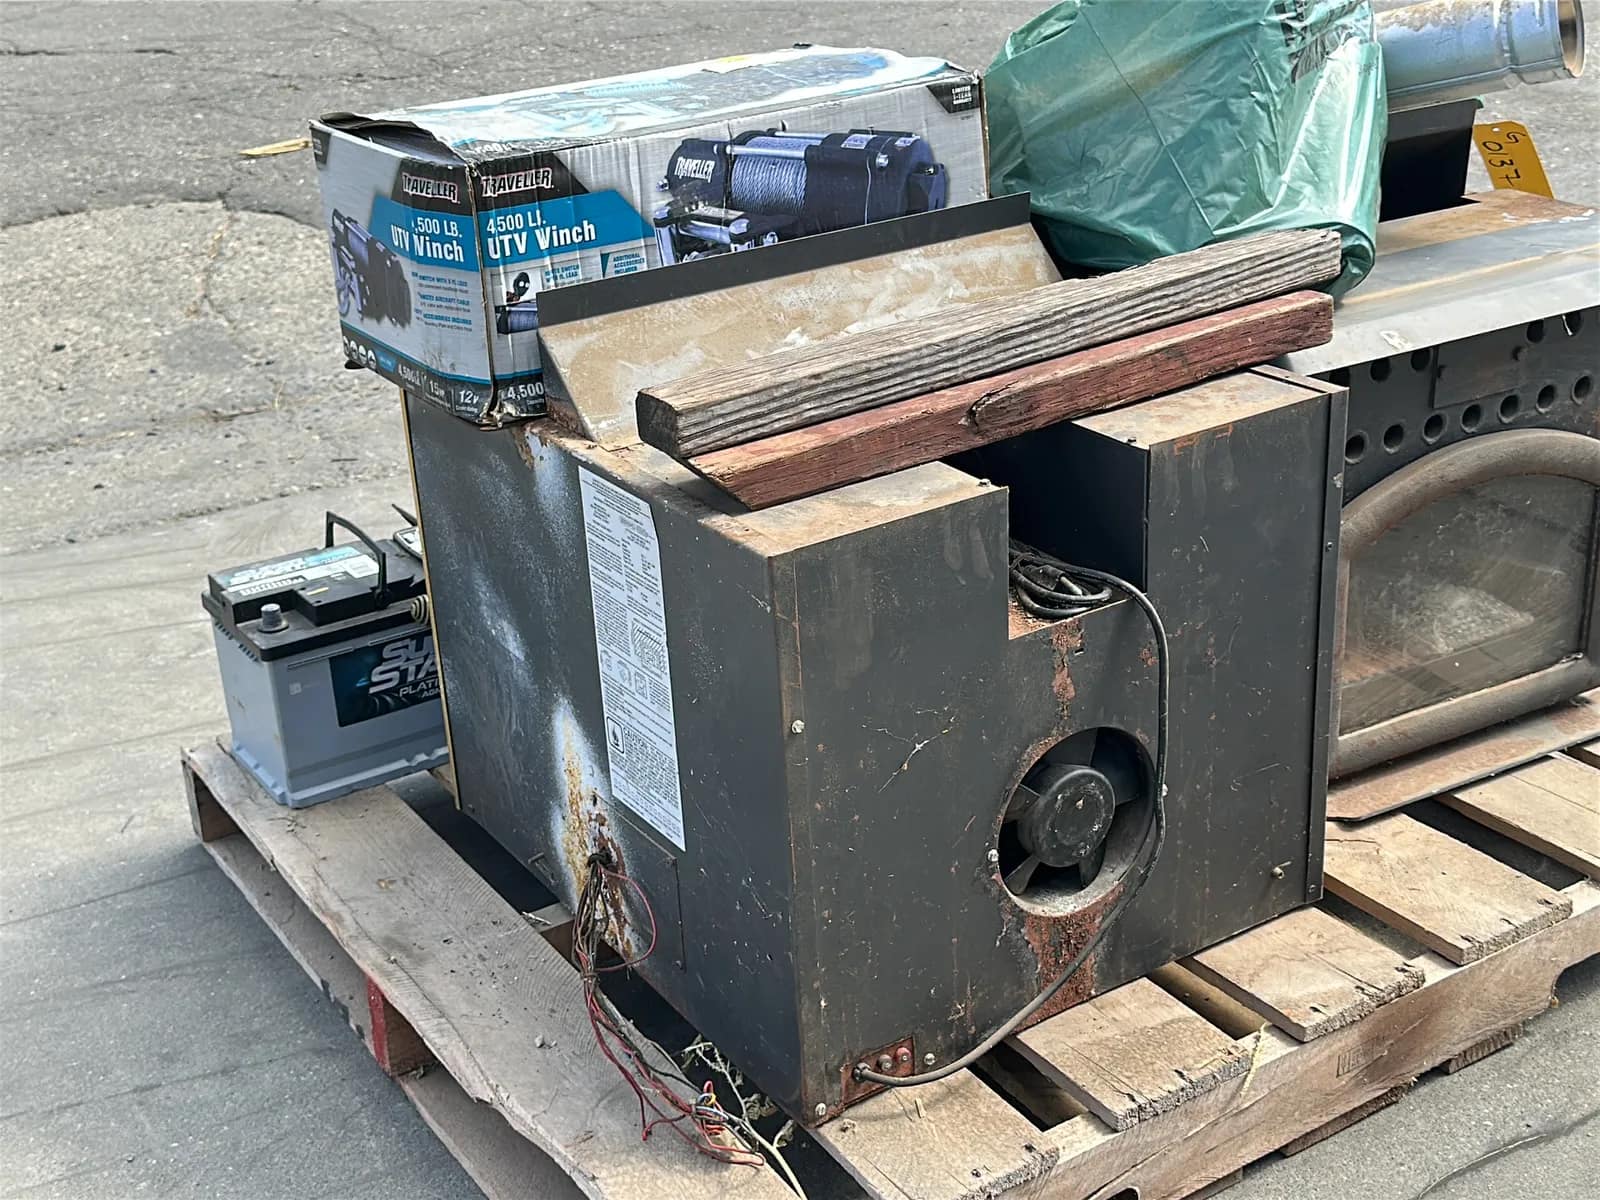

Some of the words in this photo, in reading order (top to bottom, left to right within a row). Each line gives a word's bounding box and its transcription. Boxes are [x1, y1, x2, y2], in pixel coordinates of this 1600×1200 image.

[481, 168, 553, 198] TRAVELLER
[674, 156, 716, 184] TRAVELLER
[402, 172, 459, 204] TRAVELLER
[390, 223, 410, 252] UTV
[411, 216, 441, 235] ,500
[488, 231, 528, 260] UTV
[534, 219, 597, 251] Winch
[507, 382, 545, 401] 4,500
[382, 635, 434, 668] SU
[368, 654, 439, 695] STA
[399, 678, 439, 698] PLATI
